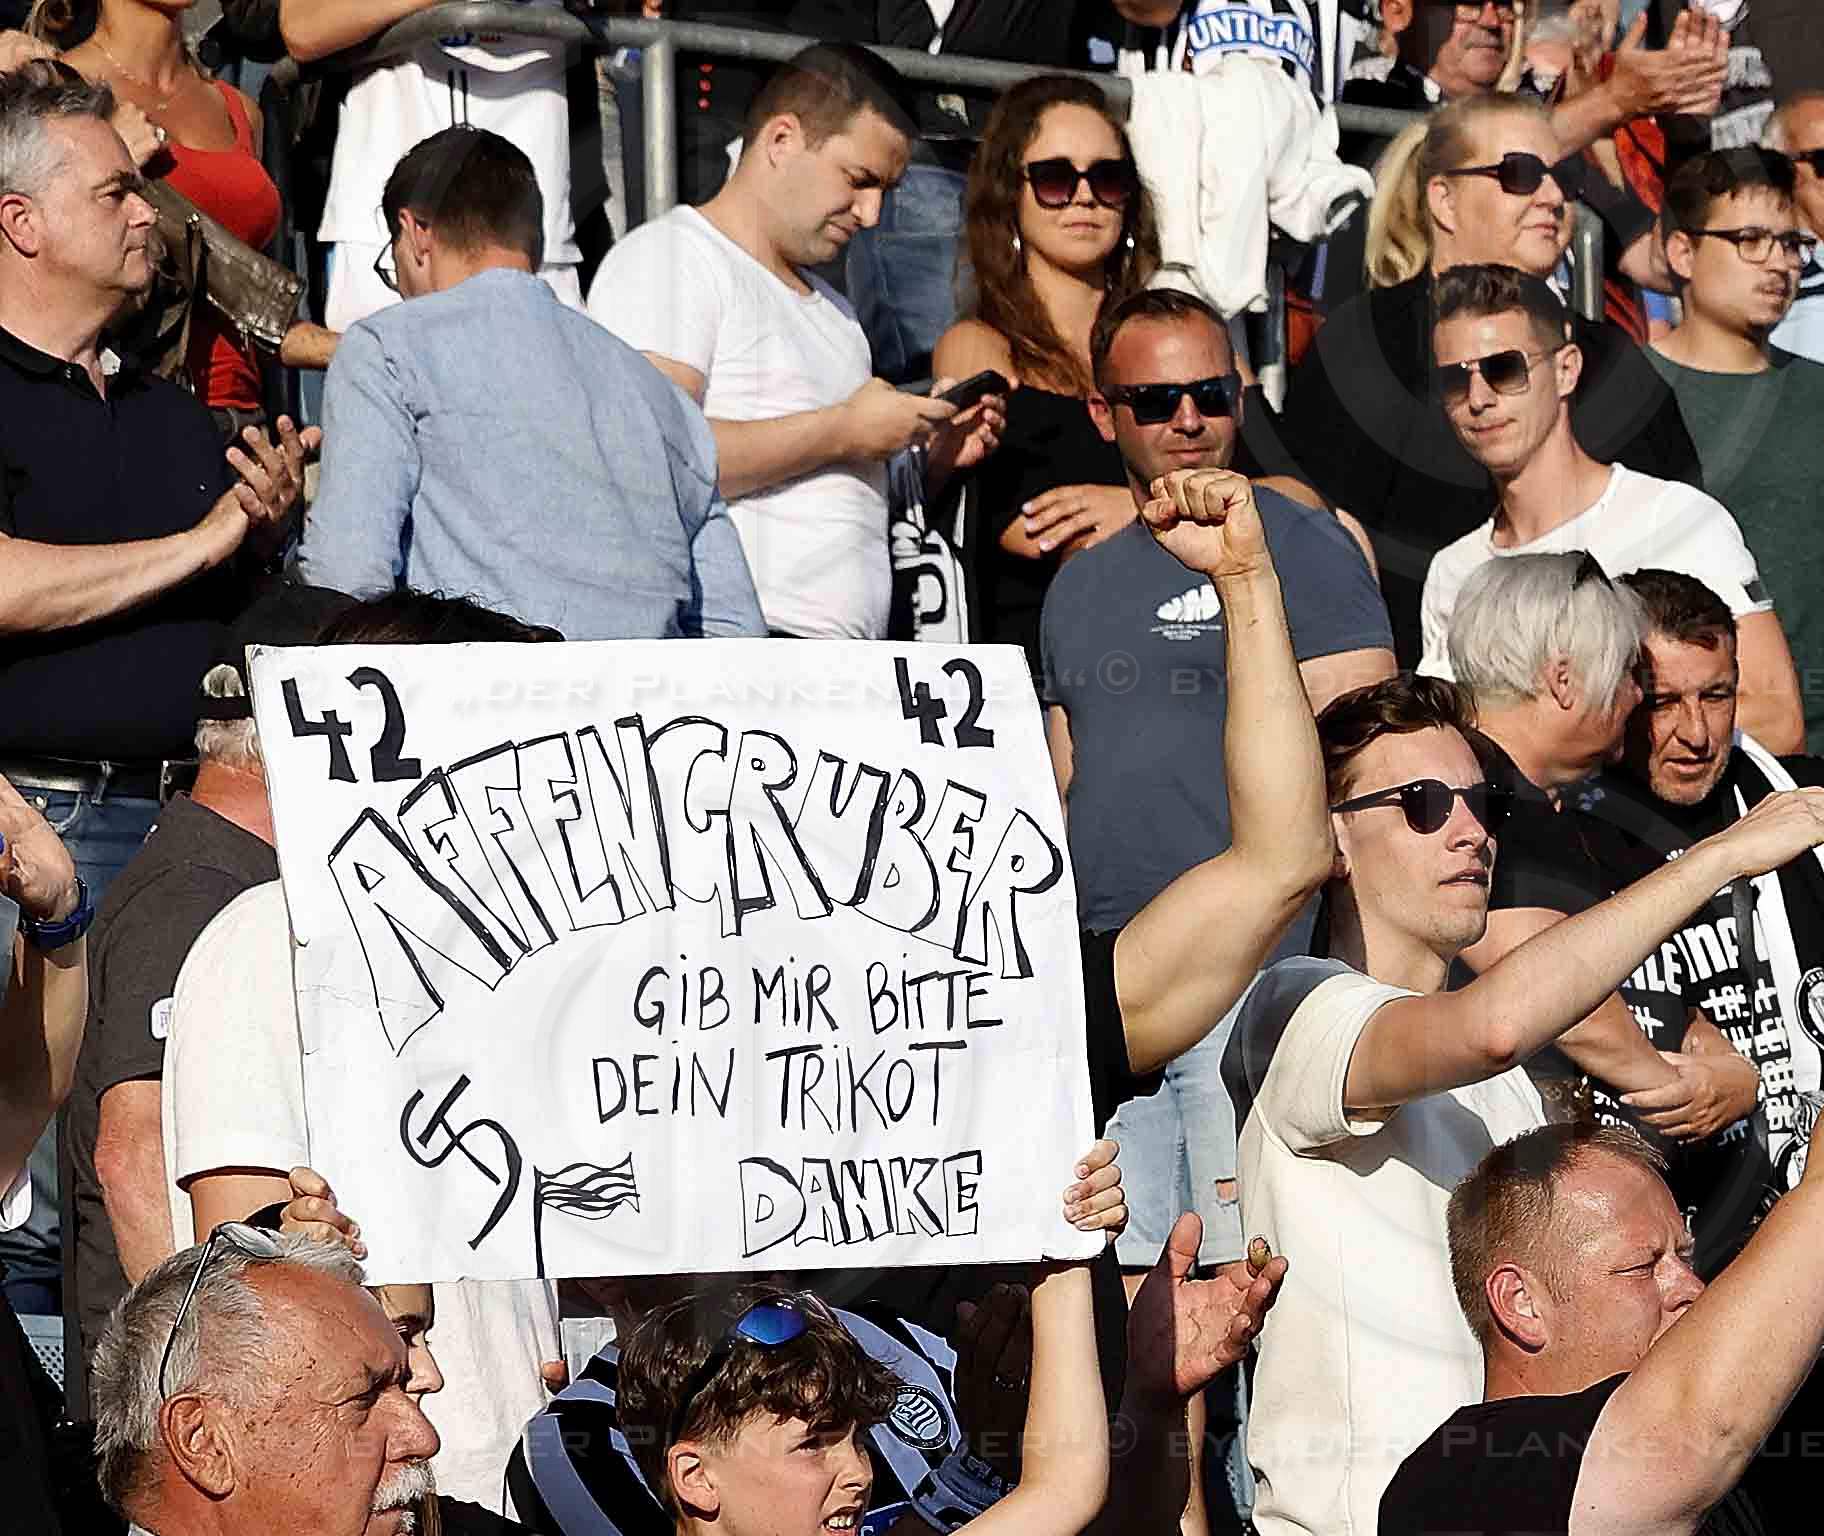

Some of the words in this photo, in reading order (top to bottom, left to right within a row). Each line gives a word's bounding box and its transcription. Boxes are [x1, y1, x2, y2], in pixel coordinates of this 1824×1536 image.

[281, 666, 422, 784] 42
[893, 657, 994, 749] 42
[328, 714, 1064, 1052] AFFENGRUBER
[738, 1150, 983, 1258] DANKE
